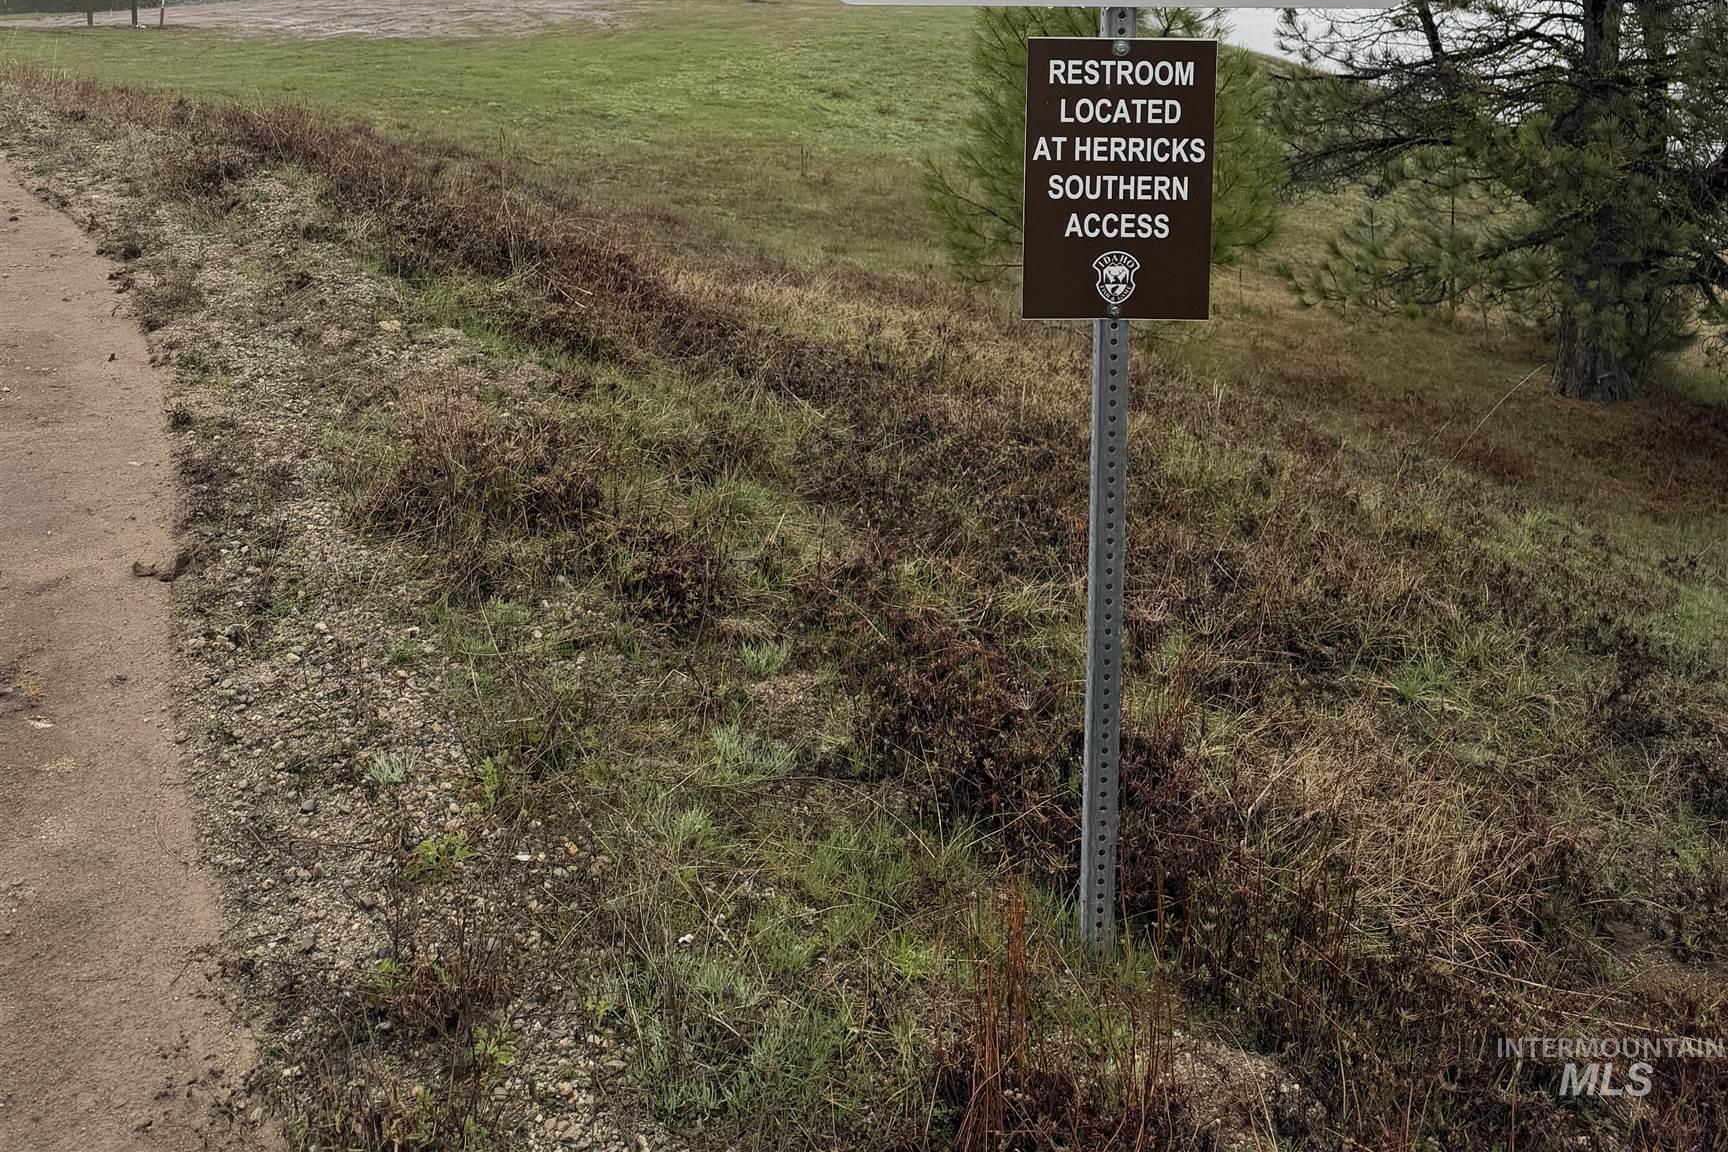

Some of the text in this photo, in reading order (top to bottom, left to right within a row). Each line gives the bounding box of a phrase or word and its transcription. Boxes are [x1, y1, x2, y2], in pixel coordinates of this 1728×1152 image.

[1049, 60, 1194, 86] RESTROOM
[1060, 98, 1182, 124] LOCATED
[1032, 136, 1206, 163] AT HERRICKS
[1048, 174, 1189, 201] SOUTHERN
[1064, 213, 1170, 239] ACCESS
[1098, 254, 1135, 268] IDAHO
